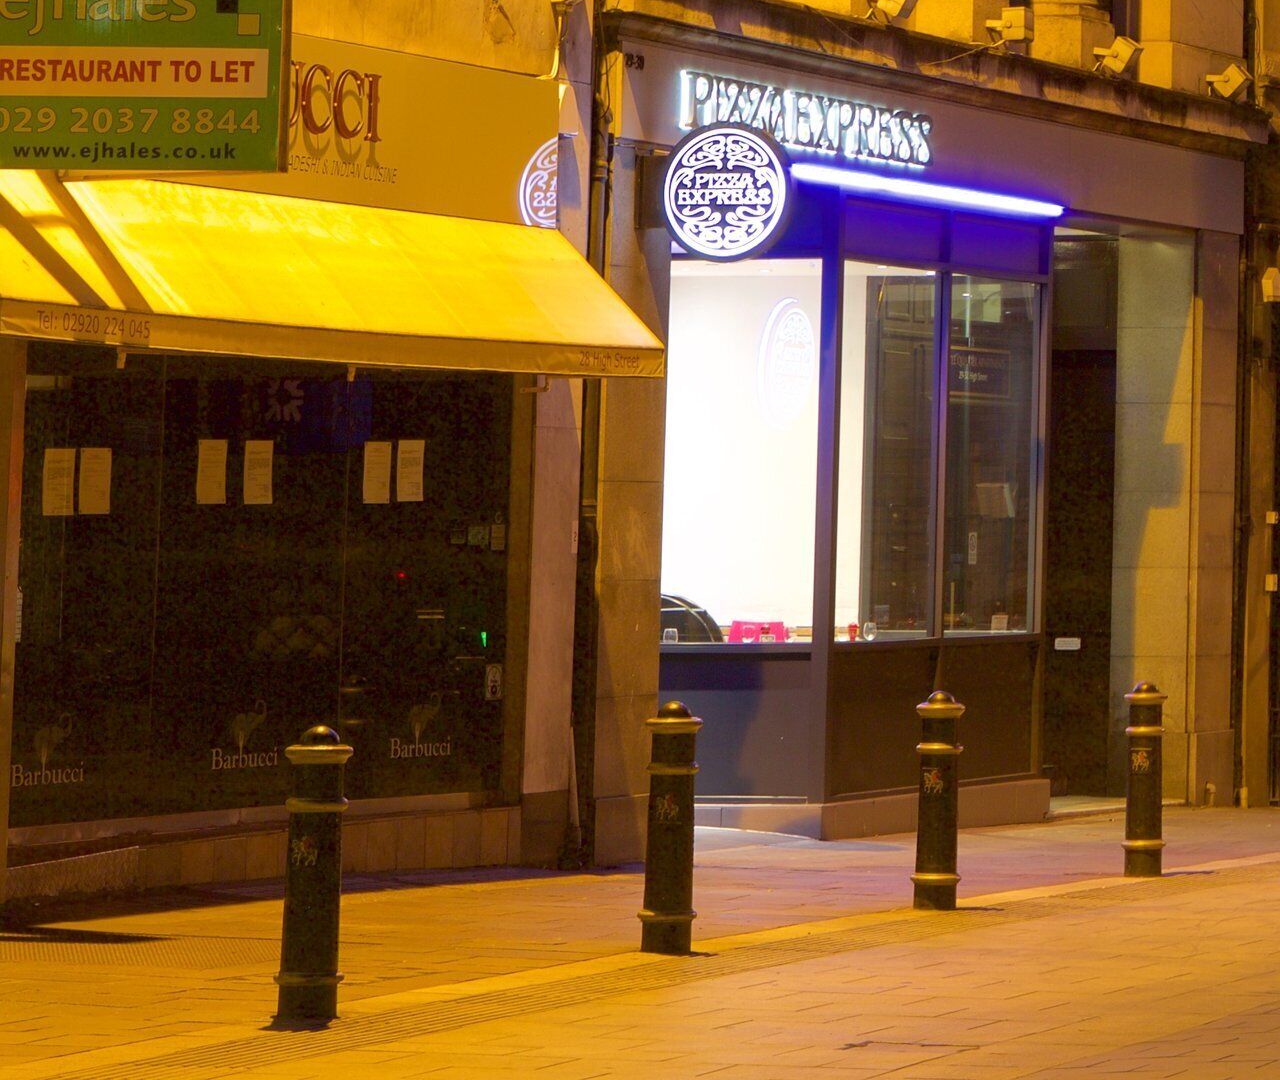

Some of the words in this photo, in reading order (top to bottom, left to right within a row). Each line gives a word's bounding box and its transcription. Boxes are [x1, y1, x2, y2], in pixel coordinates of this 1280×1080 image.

[0, 58, 162, 82] RESTAURANT
[169, 60, 202, 83] TO
[210, 60, 255, 83] LET
[70, 107, 159, 134] 2037
[170, 108, 261, 134] 8844
[13, 142, 236, 163] www.ejhales.co.uk
[330, 158, 361, 181] INDIAN
[363, 163, 399, 185] CUISINE
[695, 173, 755, 190] PIZZA
[677, 188, 772, 206] EXPRESS
[37, 310, 58, 330] Tel:
[62, 312, 99, 334] 02920
[104, 316, 124, 336] 224
[129, 319, 150, 339] 045
[580, 351, 590, 366] 28
[593, 351, 612, 371] High
[615, 353, 640, 368] Street
[210, 746, 279, 771] Barbucci
[390, 735, 451, 760] Barbucci
[11, 760, 85, 788] Barbucci
